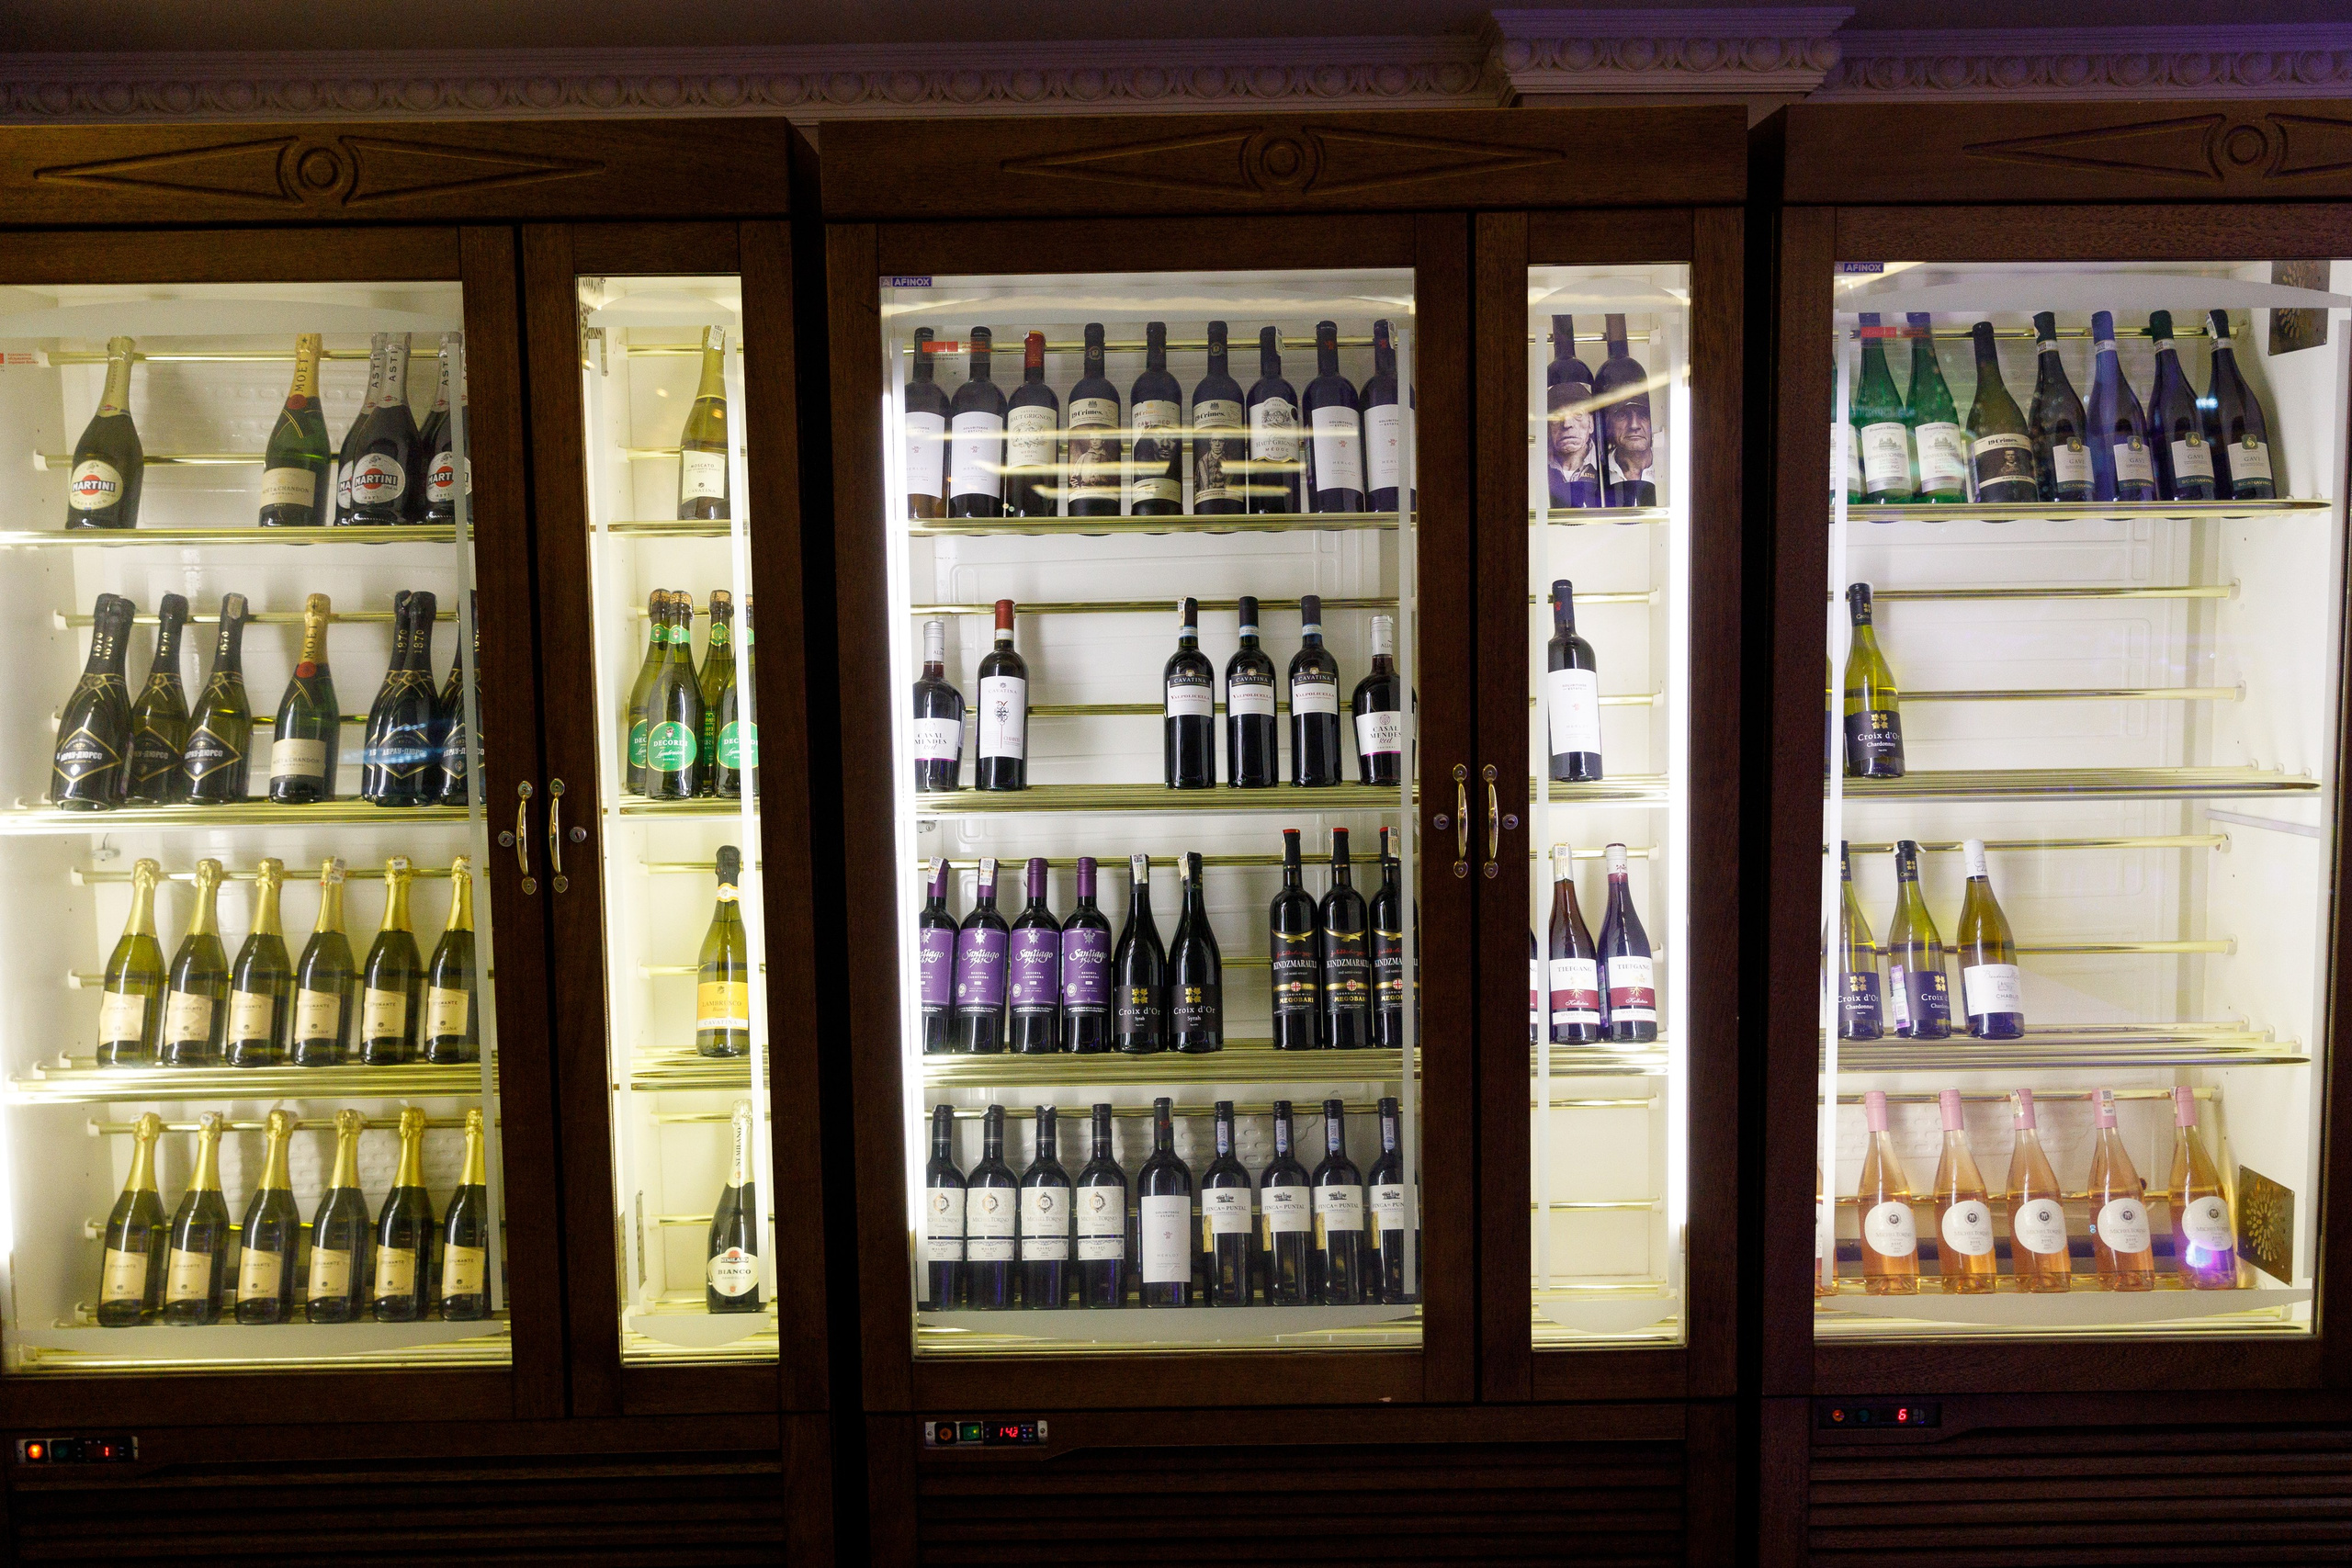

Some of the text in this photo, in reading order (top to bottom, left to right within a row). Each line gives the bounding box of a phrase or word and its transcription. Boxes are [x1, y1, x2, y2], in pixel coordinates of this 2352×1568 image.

[1846, 264, 1882, 272] AFINOX
[894, 277, 930, 287] AFINOX
[370, 354, 380, 389] ASTI
[389, 349, 398, 382] ASTI
[72, 480, 115, 492] MARTINI
[356, 474, 397, 486] MARTINI
[413, 629, 424, 654] 1870
[1857, 732, 1883, 742] Croix
[961, 948, 1000, 964] Santiago
[1015, 948, 1054, 964] Santiago
[1069, 948, 1108, 964] Santiago
[1273, 959, 1317, 970] KINDZMARAULI
[1326, 958, 1370, 969] KINDZMARAULI
[1118, 1007, 1140, 1016] Croix
[1143, 1007, 1160, 1015] d'Or
[1173, 1005, 1216, 1015] Croix d'Or
[1897, 1408, 1907, 1420] 6
